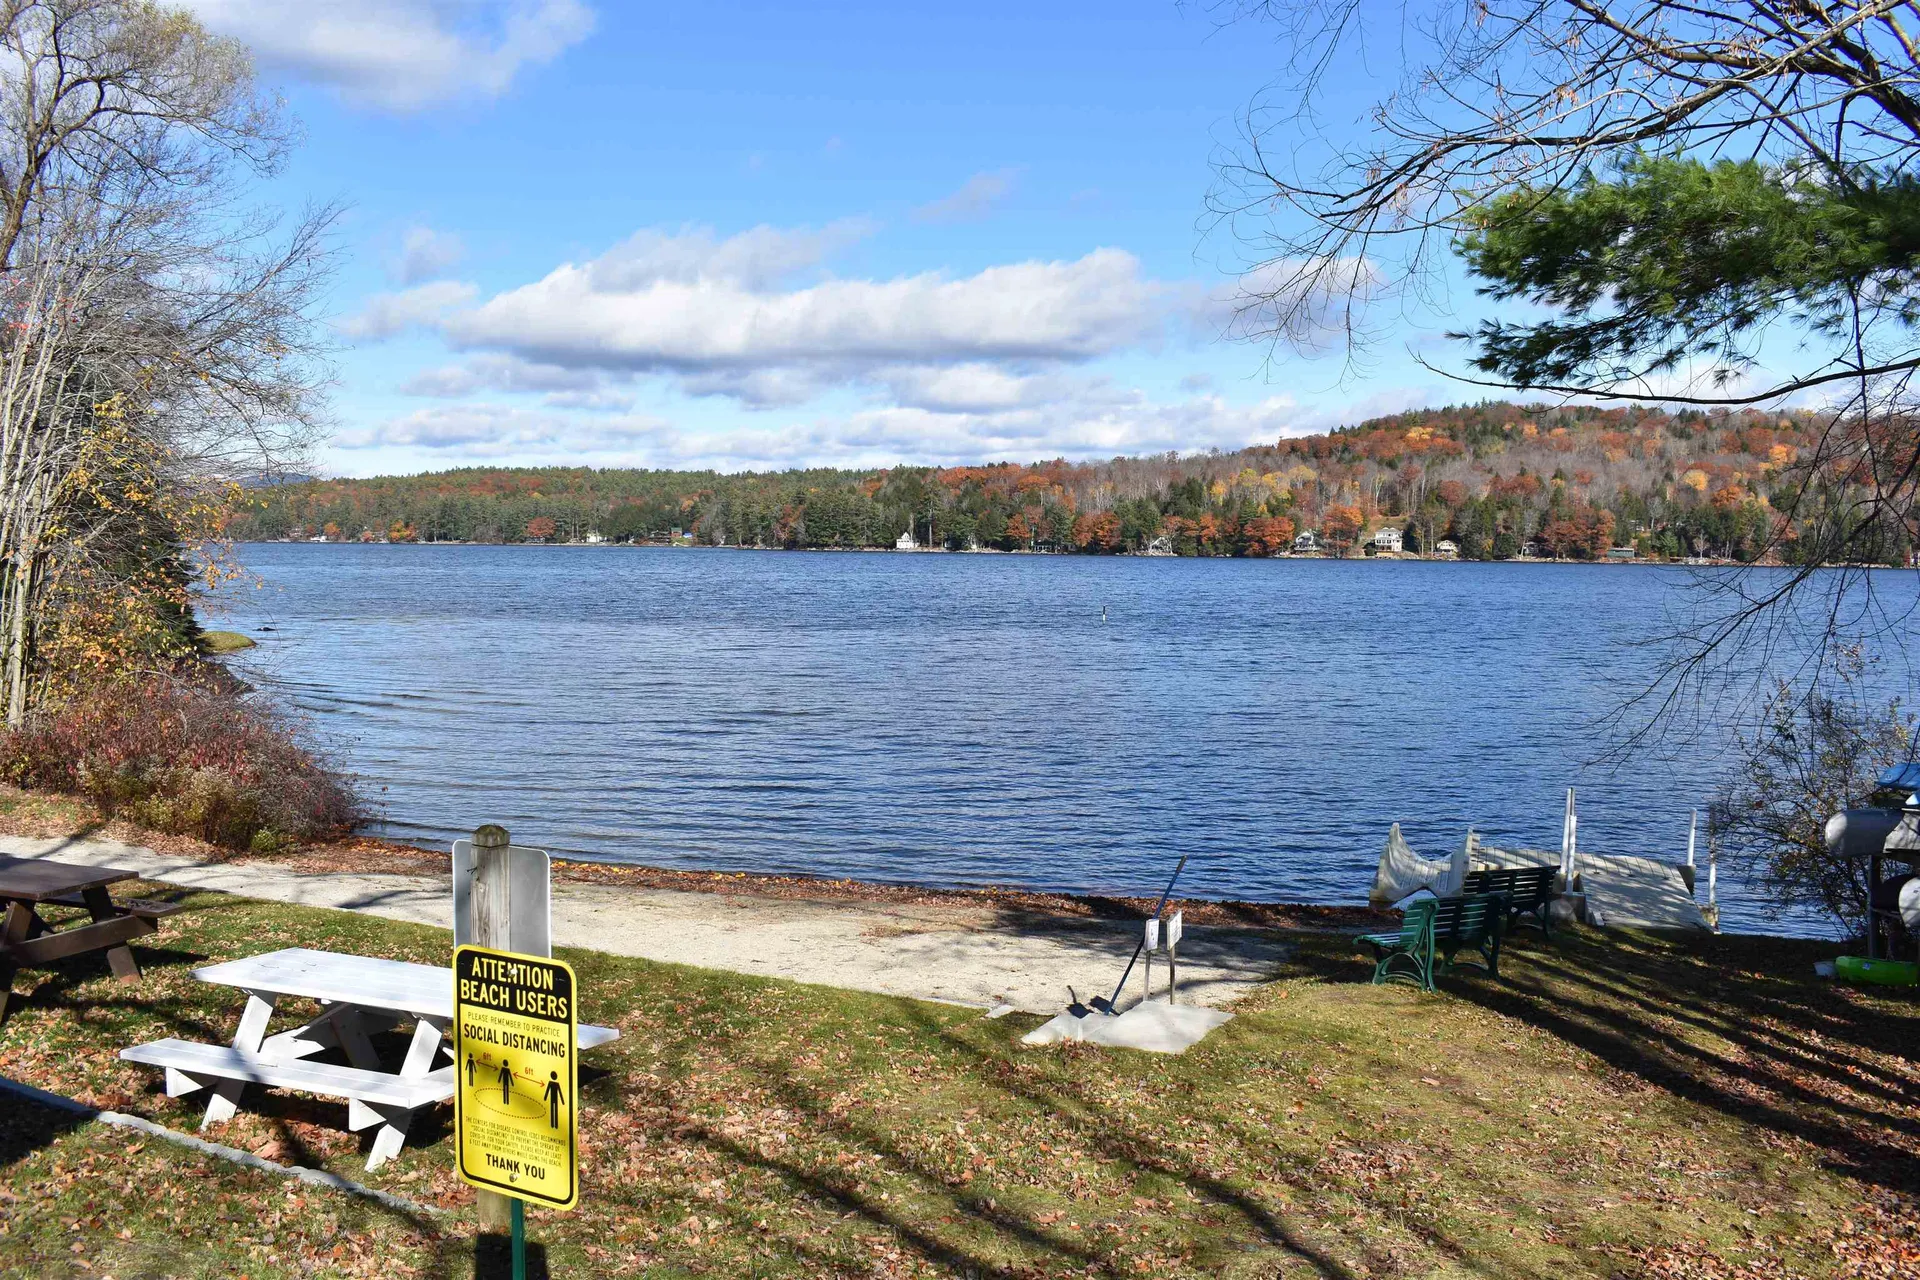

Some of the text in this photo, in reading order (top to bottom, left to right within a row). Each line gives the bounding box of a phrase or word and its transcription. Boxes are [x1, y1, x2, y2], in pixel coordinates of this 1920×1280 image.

[472, 957, 553, 990] ATTENTION
[461, 979, 567, 1019] BEACH USERS
[467, 1012, 560, 1037] PLEASE REMEMBER TO PRACTICE
[464, 1023, 565, 1058] SOCIAL DISTANCING
[483, 1052, 491, 1060] 6ft
[525, 1067, 533, 1075] 6ft
[485, 1153, 545, 1180] THANK YOU
